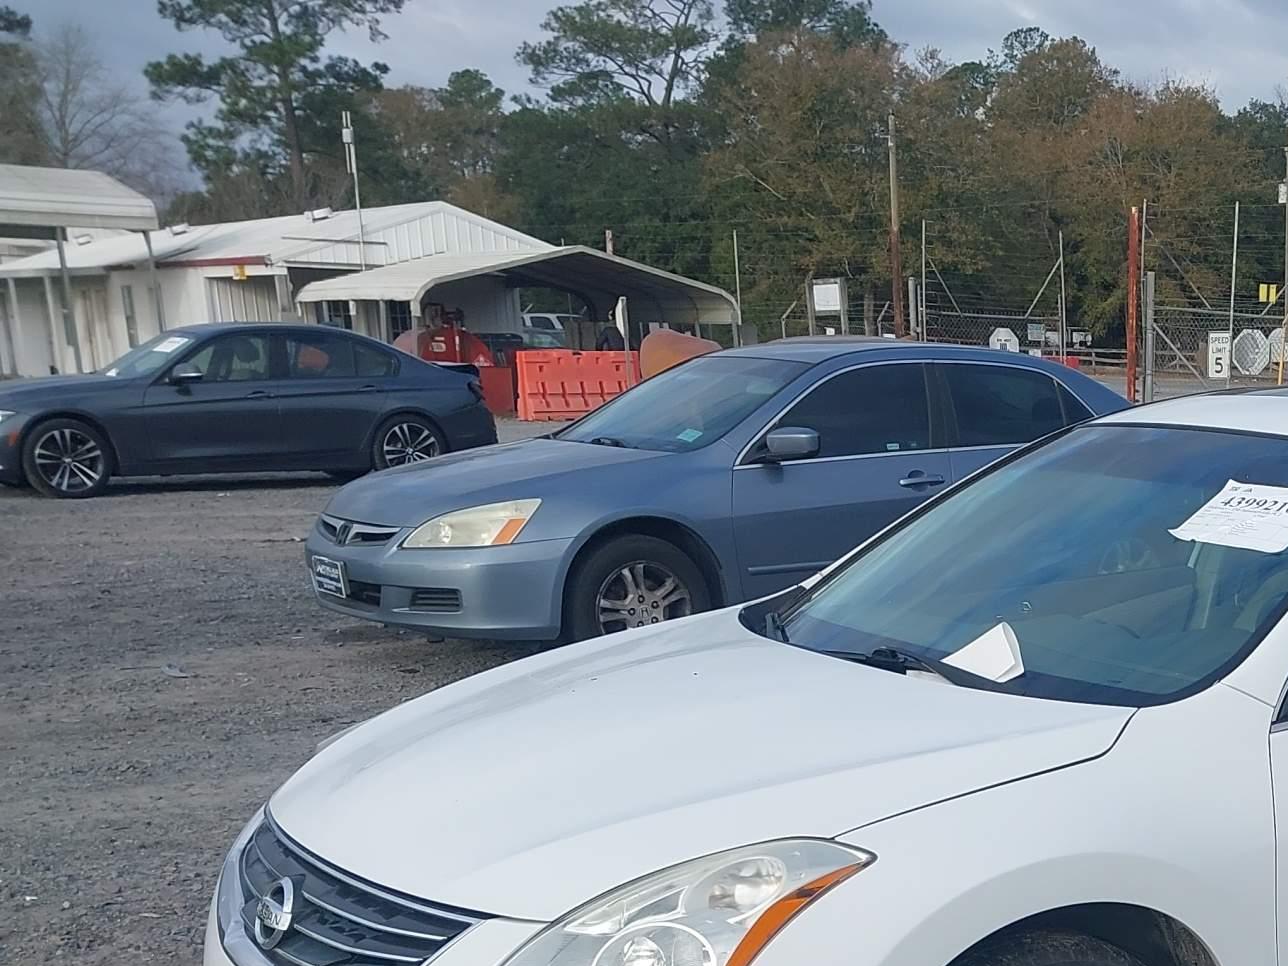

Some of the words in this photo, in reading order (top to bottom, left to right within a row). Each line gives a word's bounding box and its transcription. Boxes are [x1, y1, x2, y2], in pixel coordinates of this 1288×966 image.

[1210, 336, 1230, 344] SPEED
[1211, 346, 1227, 354] LIMIT
[1214, 357, 1224, 374] 5
